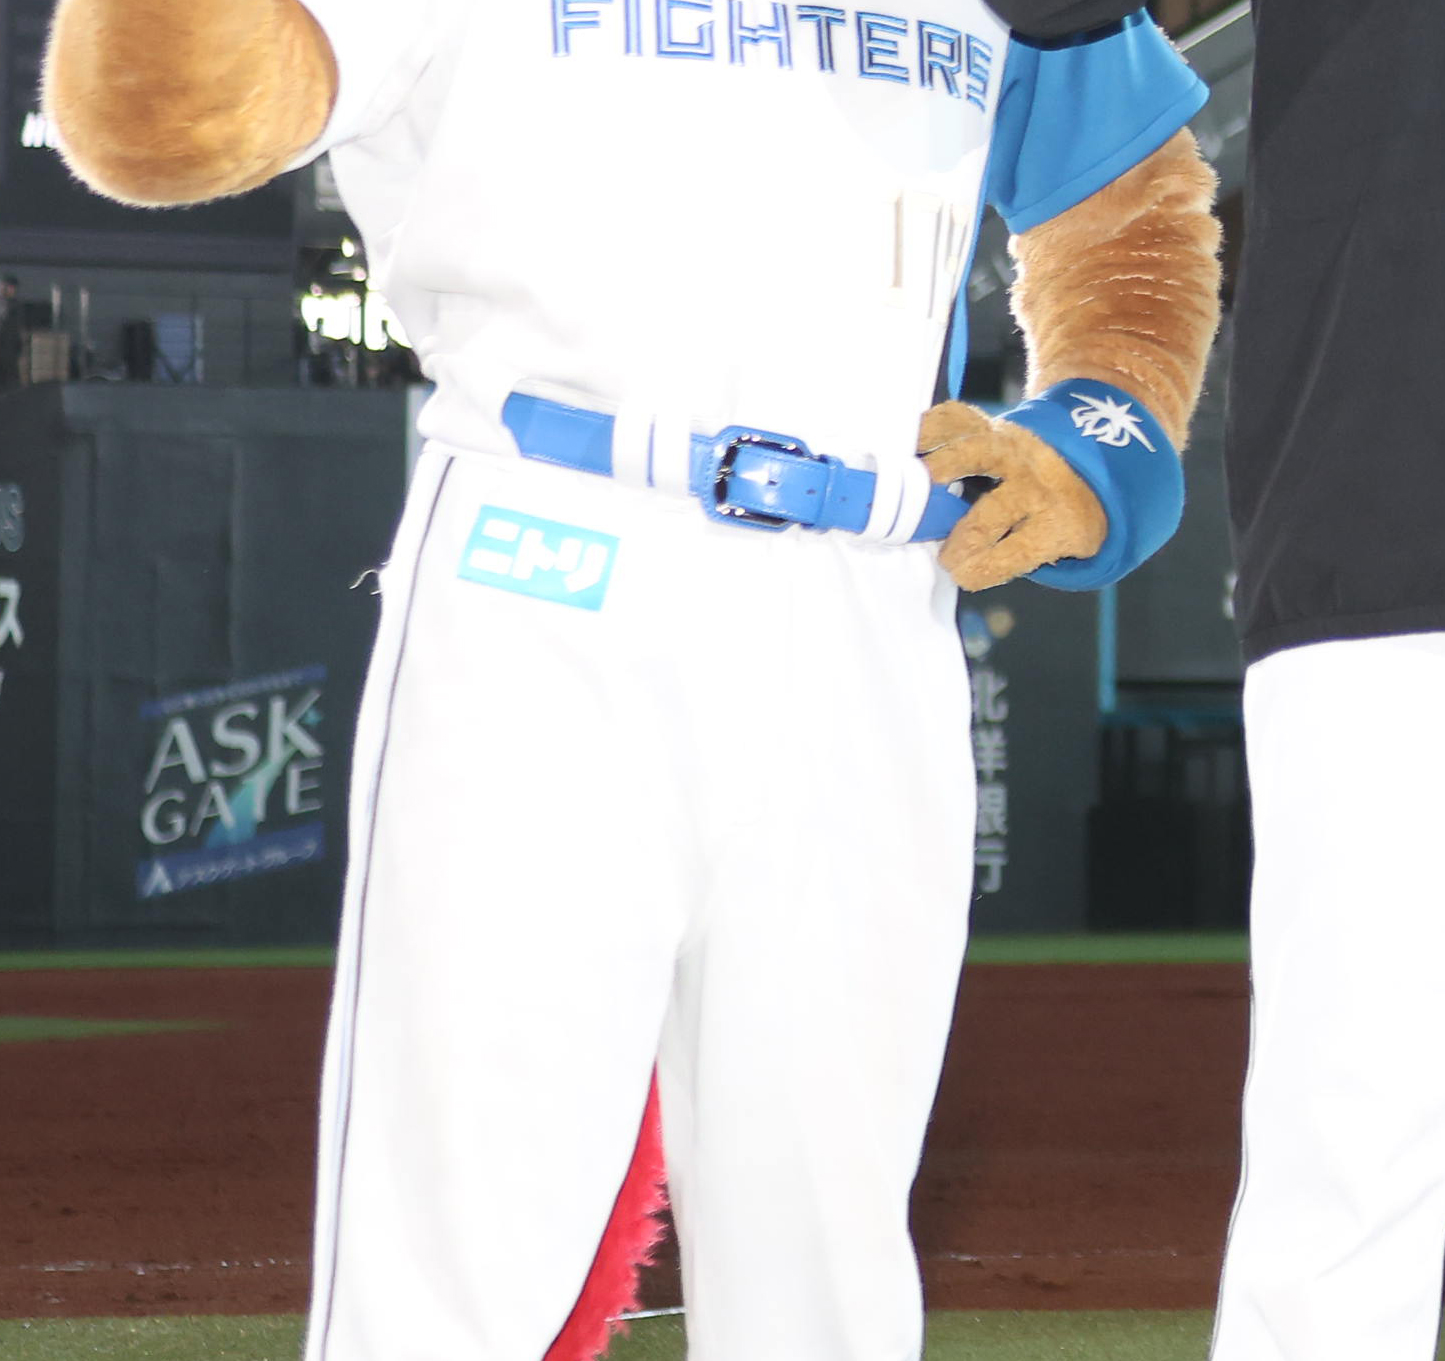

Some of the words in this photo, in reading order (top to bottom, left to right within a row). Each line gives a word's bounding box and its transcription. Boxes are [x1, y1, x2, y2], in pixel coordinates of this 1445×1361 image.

[468, 518, 609, 593] ニトリ
[145, 688, 325, 795] ASK
[140, 756, 325, 845] GATE
